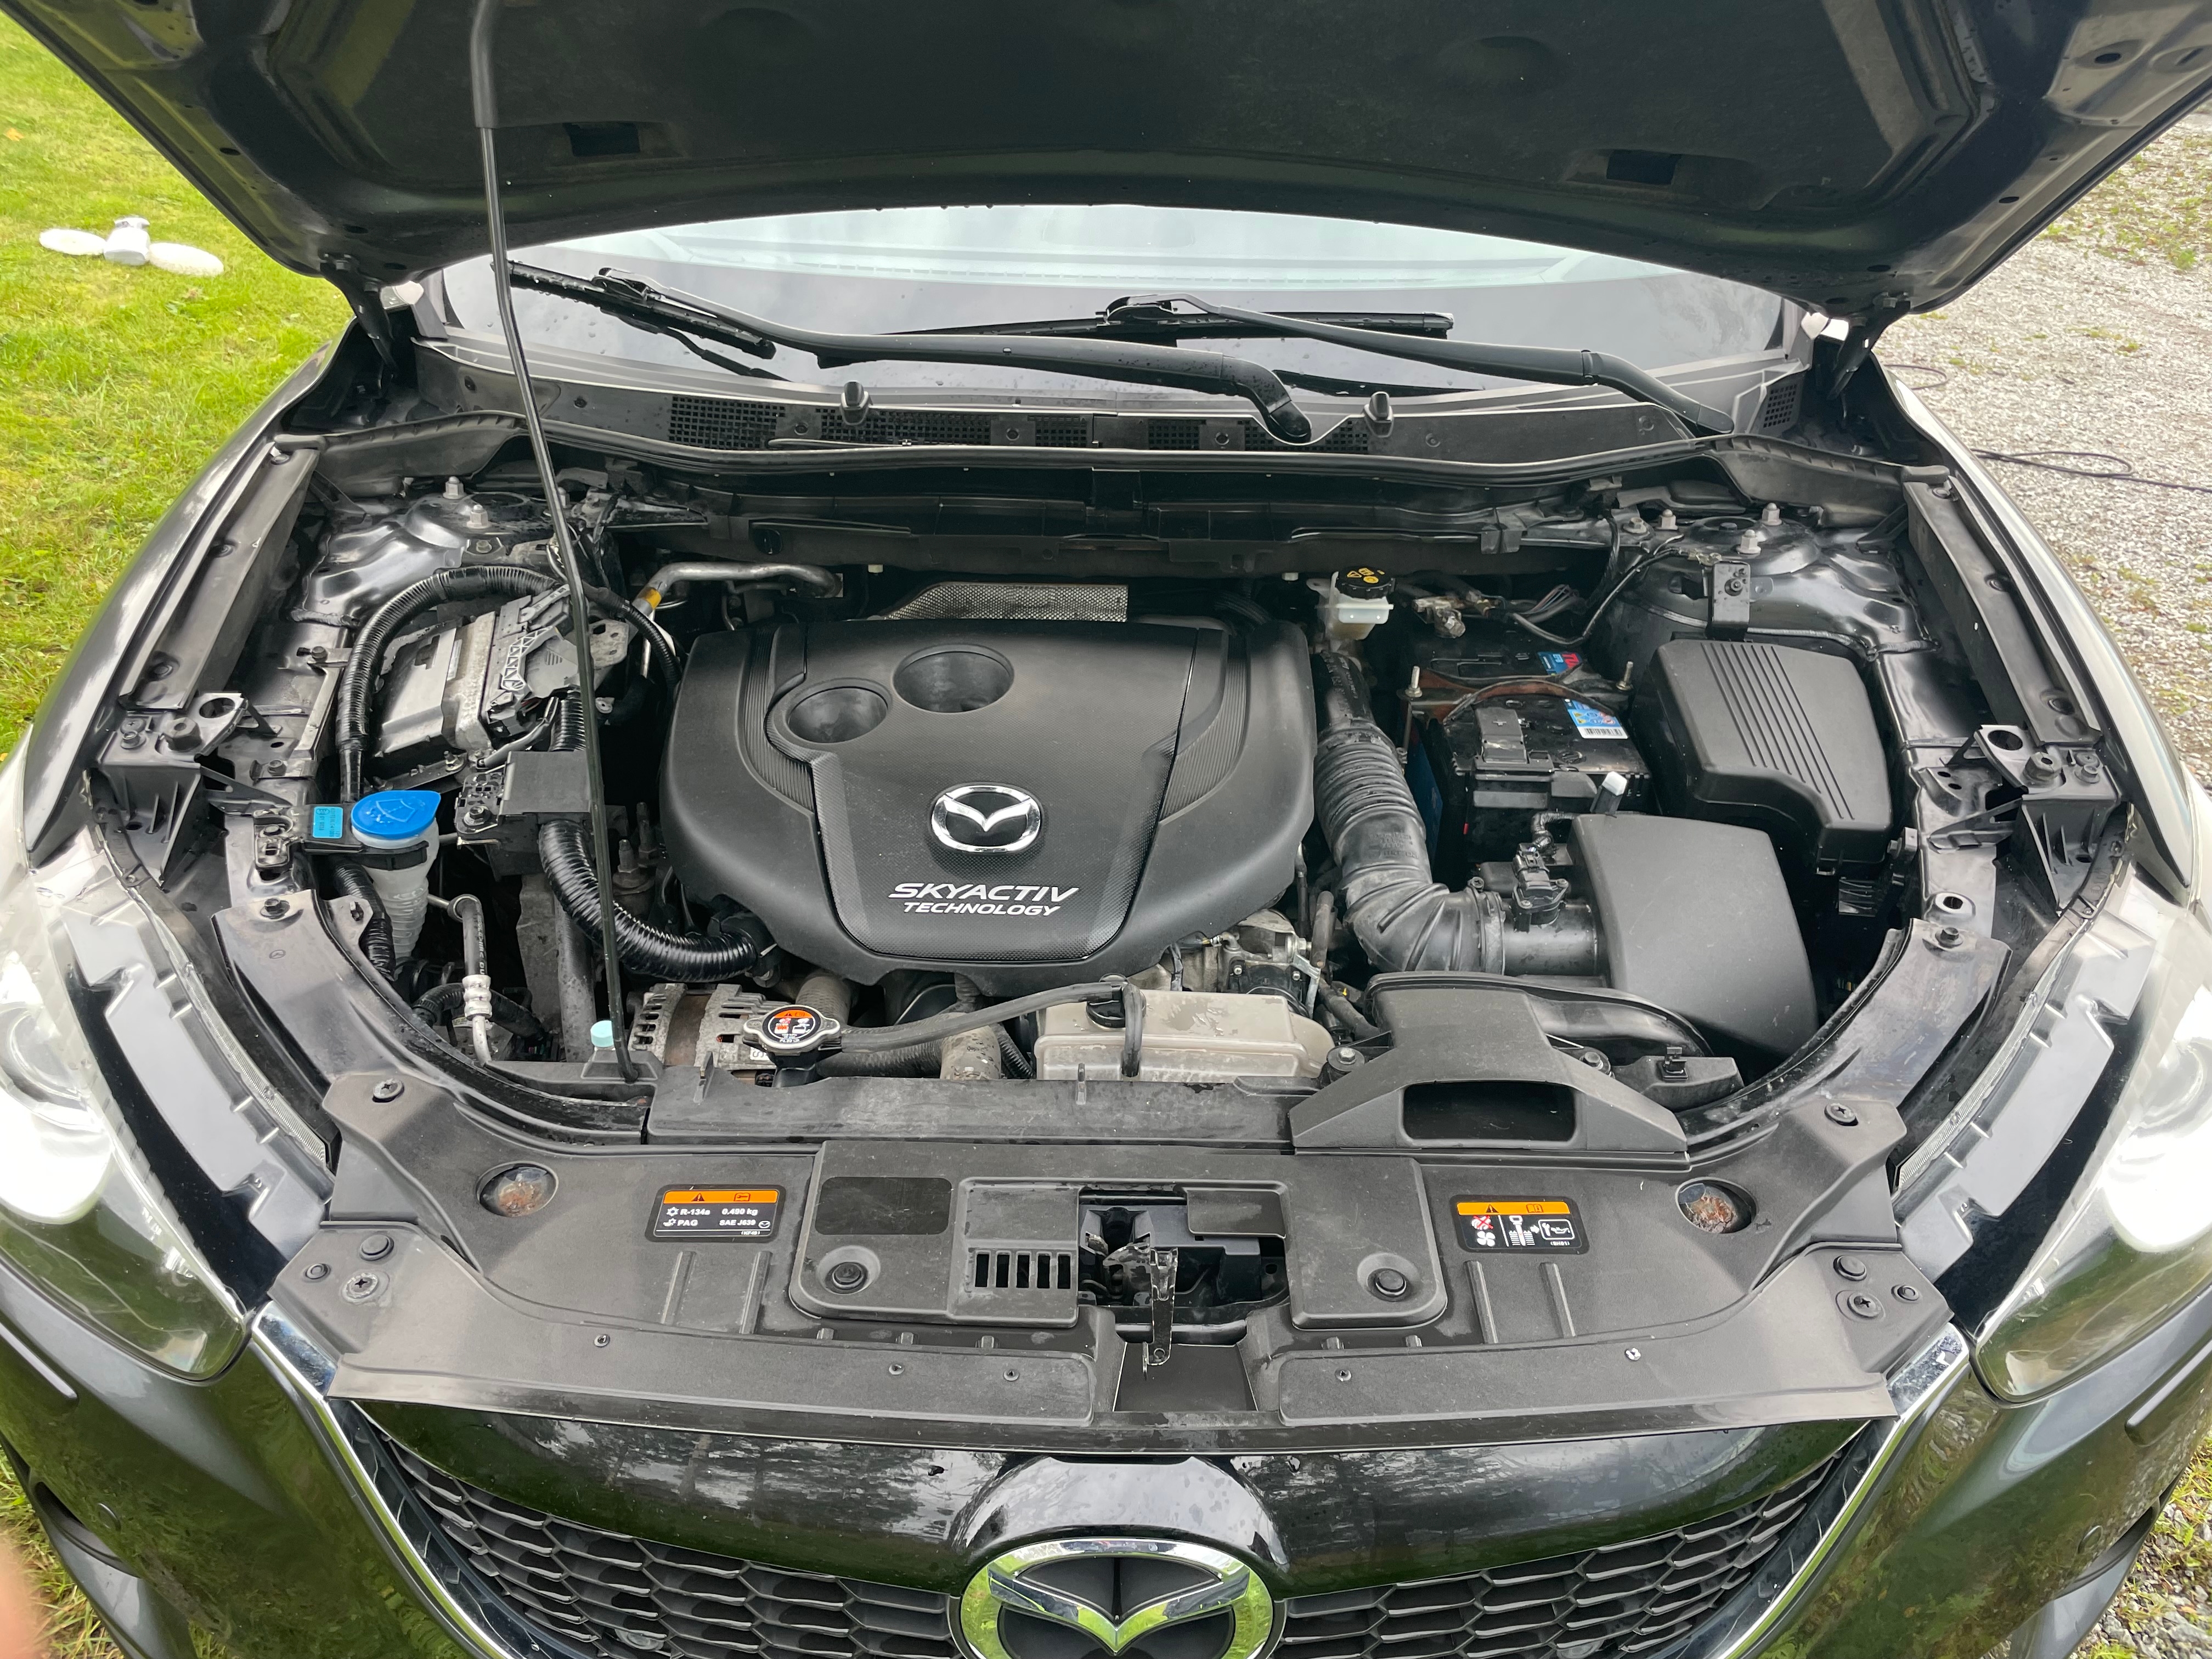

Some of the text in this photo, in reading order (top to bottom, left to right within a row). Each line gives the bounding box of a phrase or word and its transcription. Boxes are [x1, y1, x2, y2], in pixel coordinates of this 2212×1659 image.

[888, 882, 1080, 902] SKYACTIV
[904, 902, 1061, 916] TECHNOLOGY
[746, 1208, 758, 1216] kg
